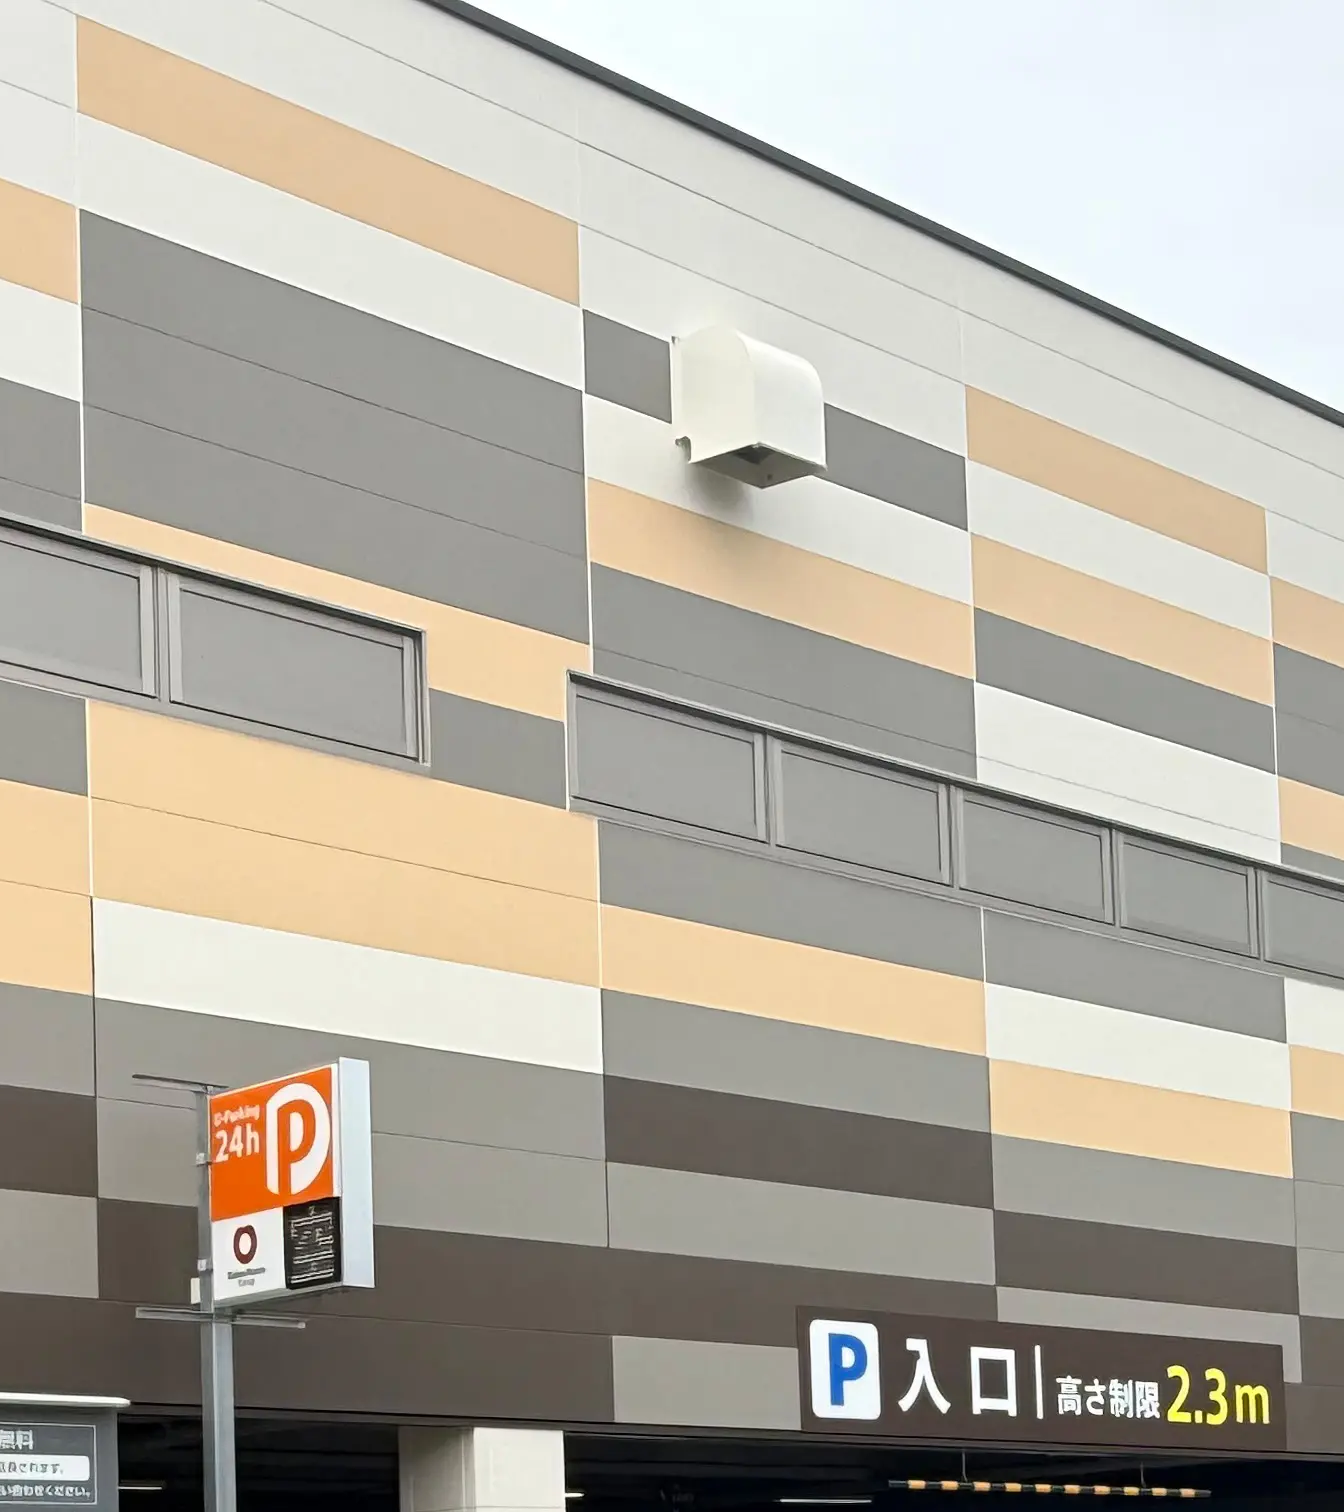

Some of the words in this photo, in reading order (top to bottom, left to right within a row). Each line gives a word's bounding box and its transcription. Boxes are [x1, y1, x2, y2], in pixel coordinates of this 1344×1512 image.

[215, 1123, 260, 1162] 24h
[828, 1333, 868, 1406] P
[898, 1338, 1017, 1417] 入口
